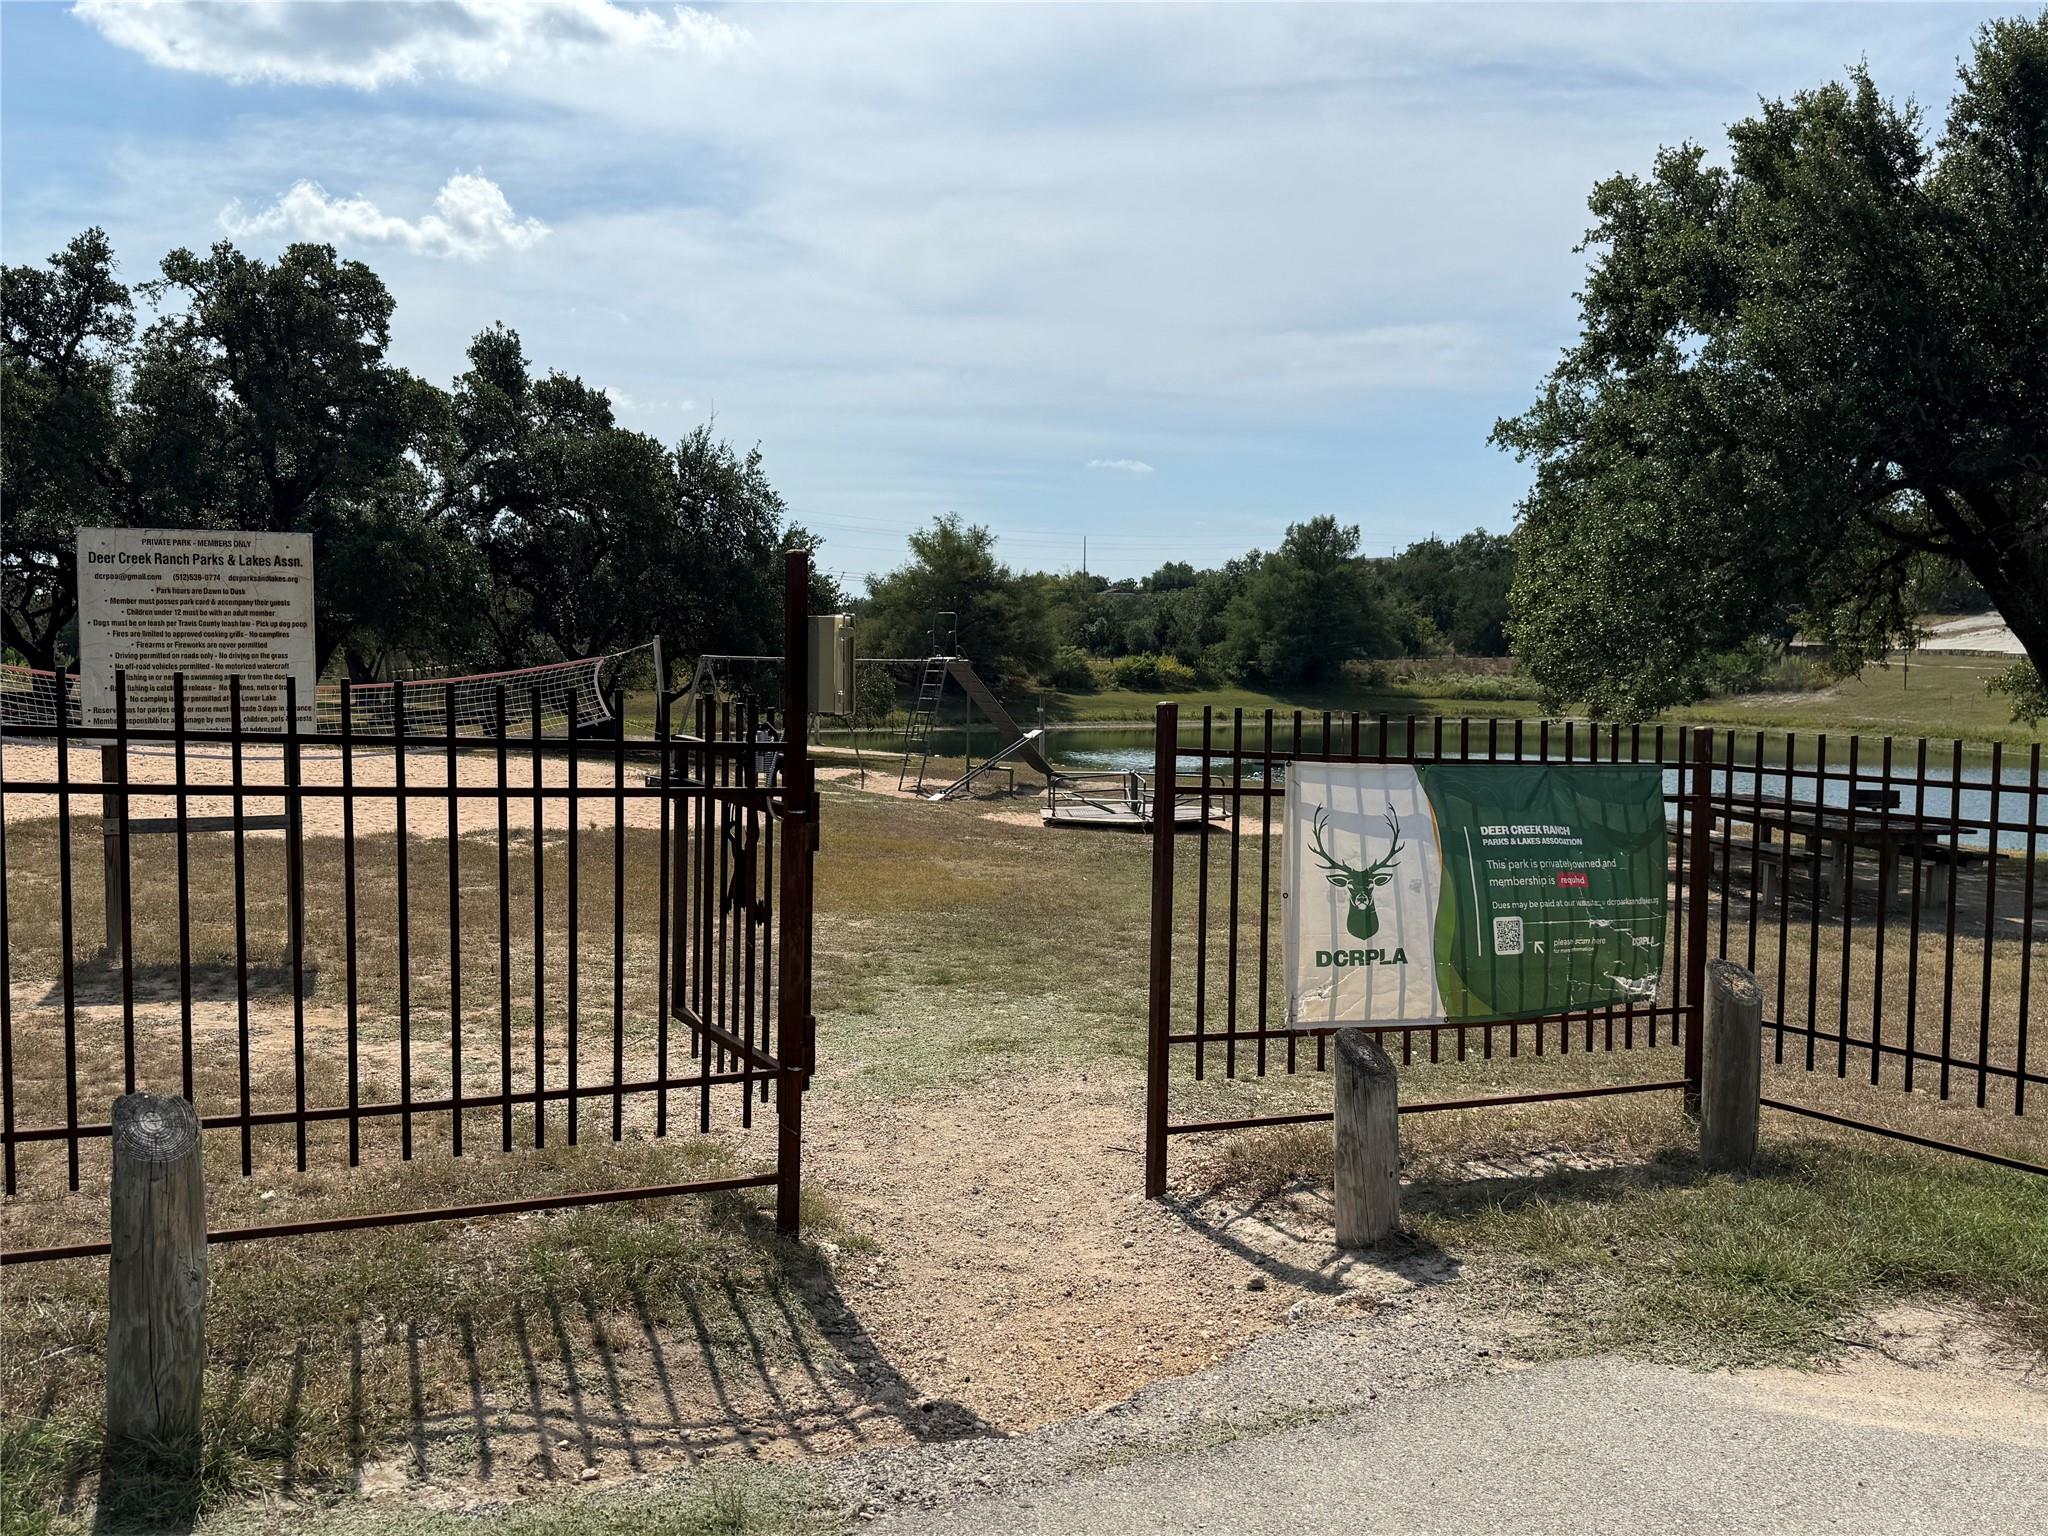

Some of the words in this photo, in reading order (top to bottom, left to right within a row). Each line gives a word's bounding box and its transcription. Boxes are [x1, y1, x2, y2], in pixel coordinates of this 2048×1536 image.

[142, 538, 170, 546] PRIVATE
[234, 540, 251, 548] ONLY
[88, 552, 116, 564] Deer
[118, 552, 152, 564] Creek
[154, 553, 190, 565] Ranch
[192, 554, 224, 566] Parks
[227, 554, 235, 566] &
[239, 555, 271, 566] Lakes
[274, 556, 303, 567] Assn.
[218, 600, 253, 608] accompany
[270, 600, 290, 608] guests
[93, 620, 109, 628] Dogs
[199, 620, 220, 628] County
[279, 621, 290, 629] dog
[173, 631, 202, 639] approved
[259, 632, 289, 640] campfires
[238, 642, 268, 650] permitted
[115, 652, 138, 660] Driving
[140, 652, 170, 660] permitted
[179, 663, 209, 671] permitted
[140, 696, 167, 704] camping
[190, 696, 220, 704] permitted
[1480, 826, 1510, 836] DEER
[1510, 825, 1542, 834] CREEK
[1543, 825, 1570, 835] RANCH
[1482, 838, 1509, 846] PARKS
[1486, 858, 1506, 869] This
[1508, 858, 1529, 871] park
[1530, 859, 1537, 868] is
[1540, 858, 1572, 870] privately
[1572, 858, 1601, 868] owned
[1602, 858, 1616, 868] and
[1489, 876, 1547, 887] membership
[1548, 875, 1556, 885] is
[1492, 901, 1510, 910] Dues
[1512, 902, 1527, 910] may
[1529, 900, 1538, 908] be
[1540, 900, 1555, 910] paid
[1316, 947, 1408, 967] DCRPLA
